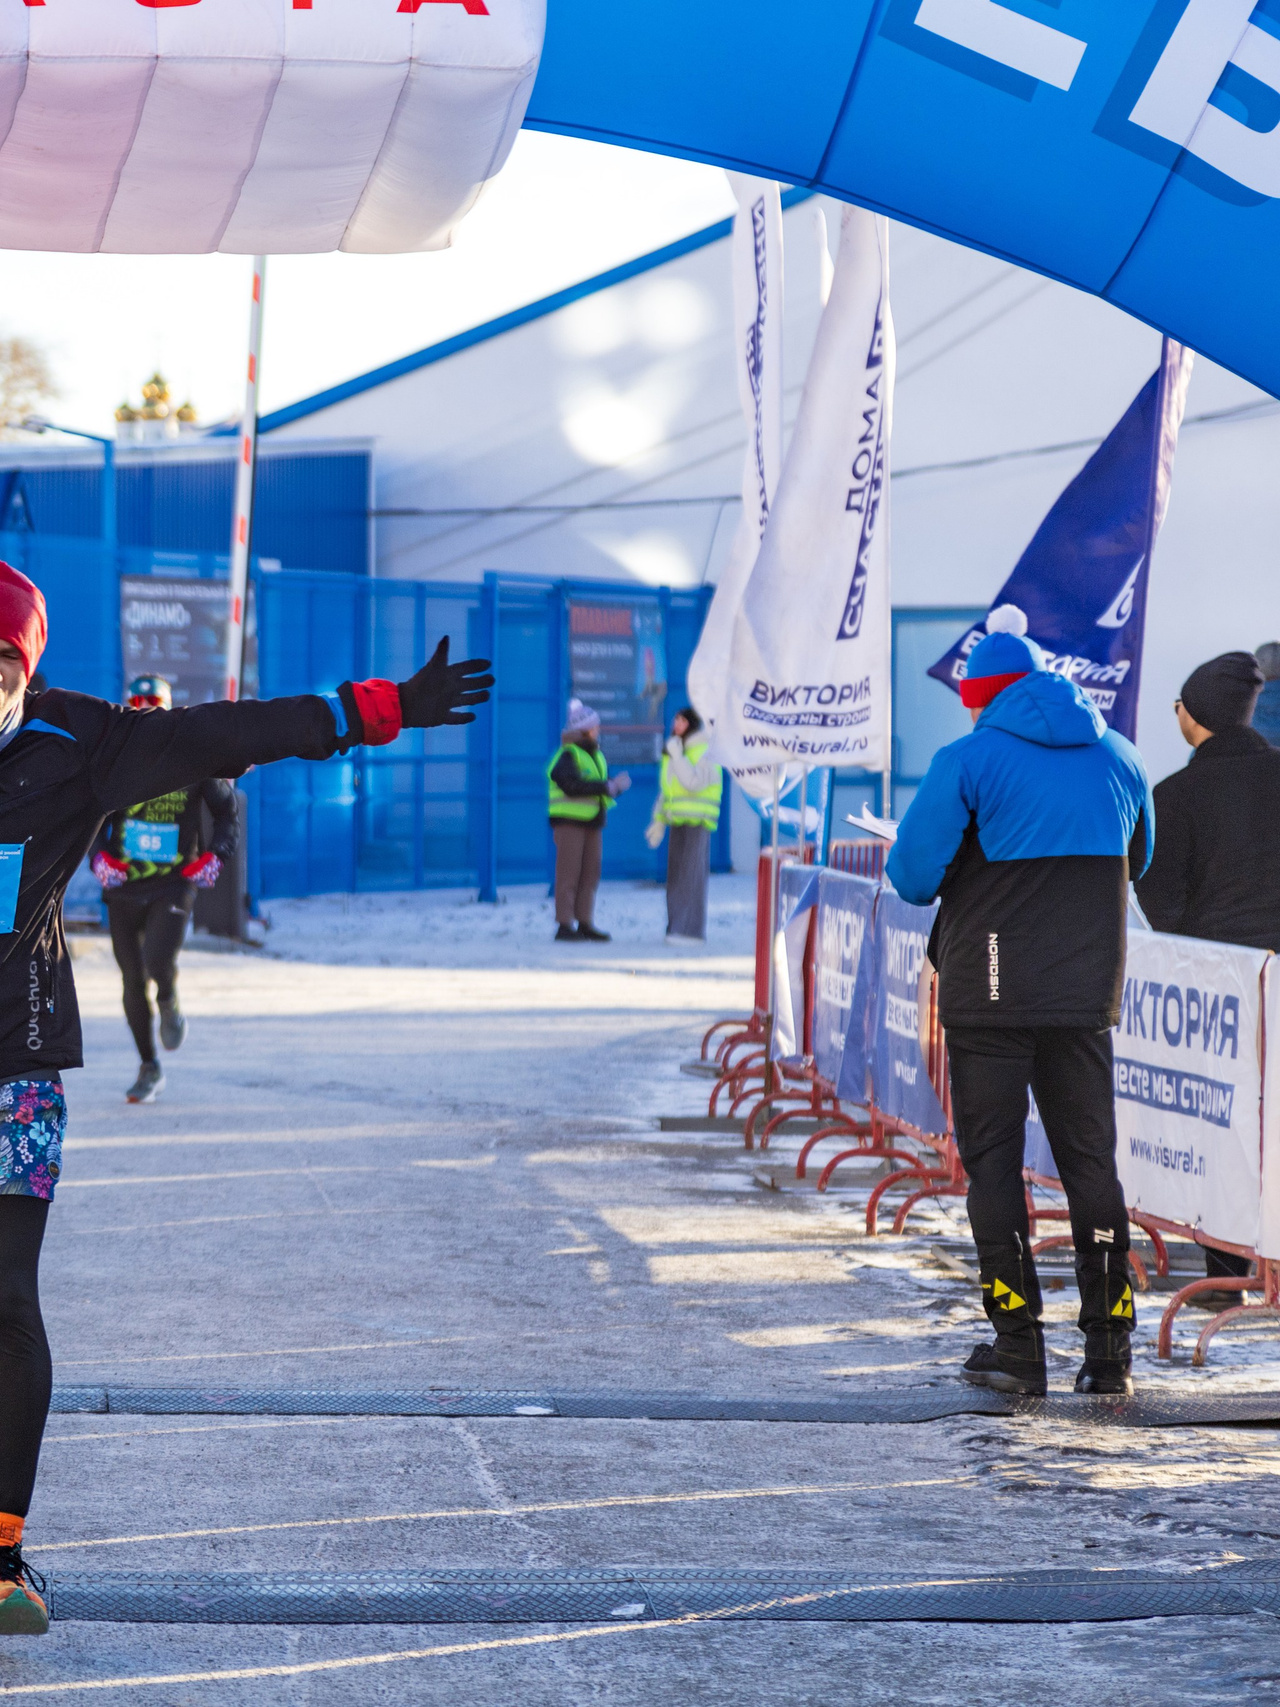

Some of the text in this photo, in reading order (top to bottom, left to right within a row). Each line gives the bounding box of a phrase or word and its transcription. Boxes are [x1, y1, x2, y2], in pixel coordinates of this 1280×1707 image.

[961, 629, 1131, 685] ВТОРИЯ
[749, 675, 872, 707] ВИКТОРИЯ
[140, 834, 162, 852] 65
[989, 933, 1000, 1001] NORDSKI
[27, 961, 43, 1051] Quechua
[1116, 977, 1240, 1060] ИКТОРИЯ
[1114, 1061, 1232, 1121] есте мы строим
